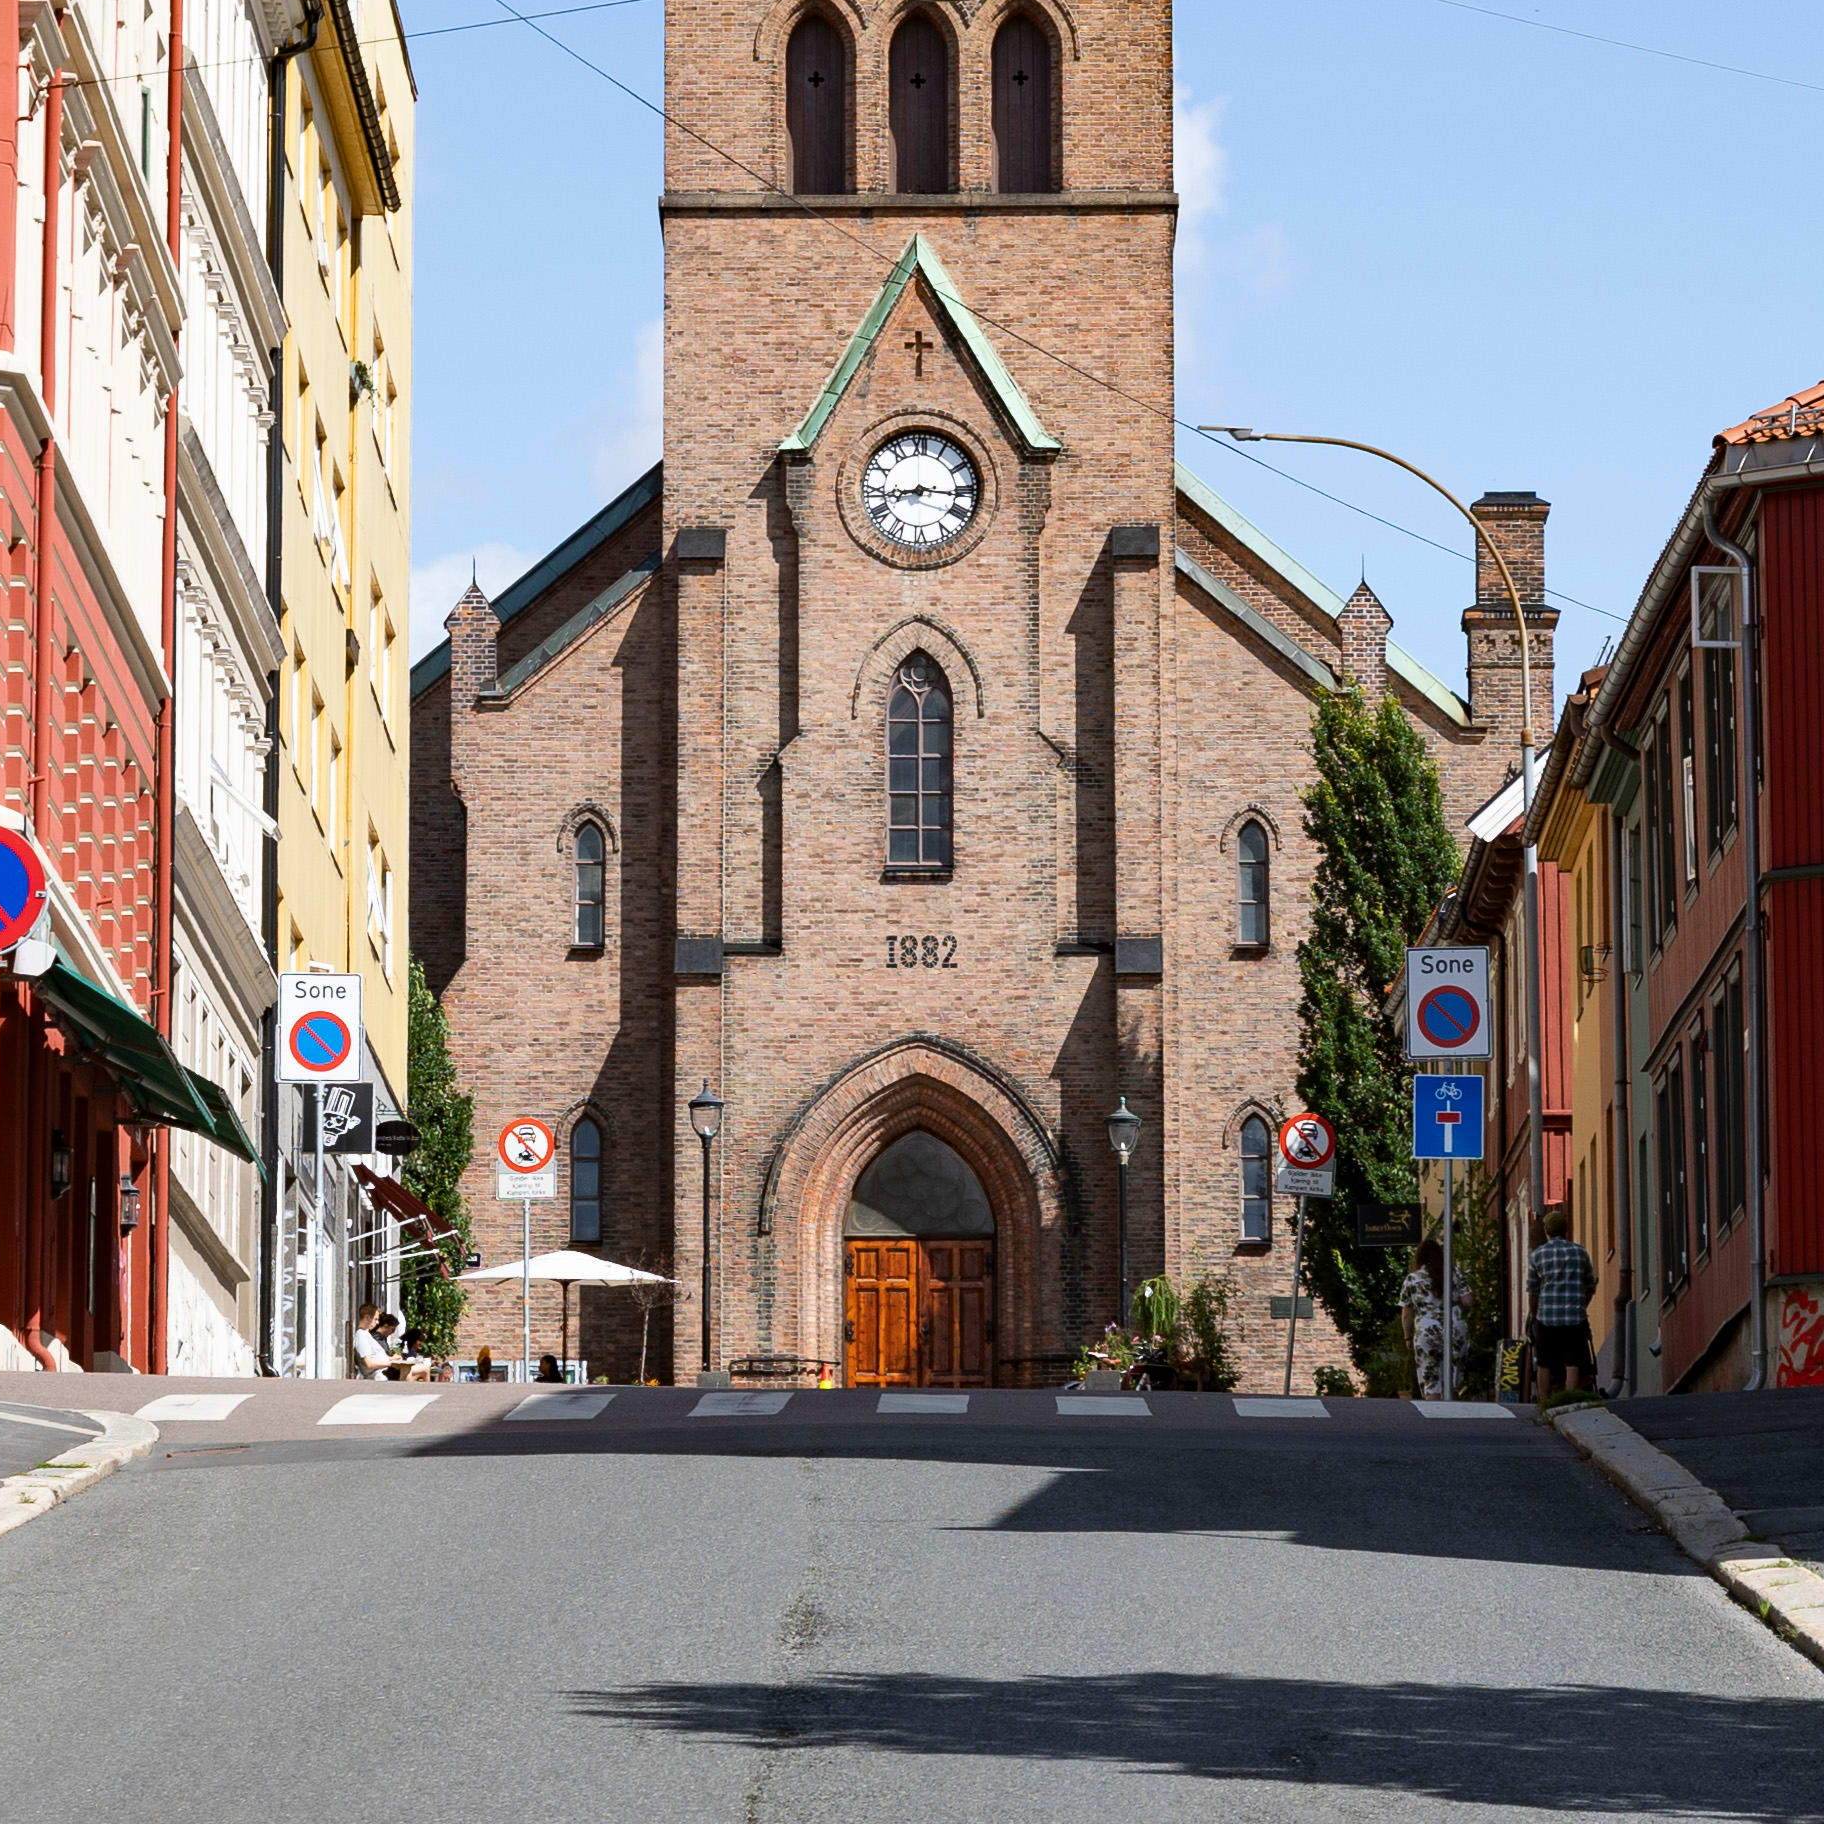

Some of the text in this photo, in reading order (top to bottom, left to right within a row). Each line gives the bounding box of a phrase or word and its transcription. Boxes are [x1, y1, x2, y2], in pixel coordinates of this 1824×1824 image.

[886, 935, 958, 968] 1882
[1421, 955, 1474, 974] Sone
[295, 980, 347, 999] Sone
